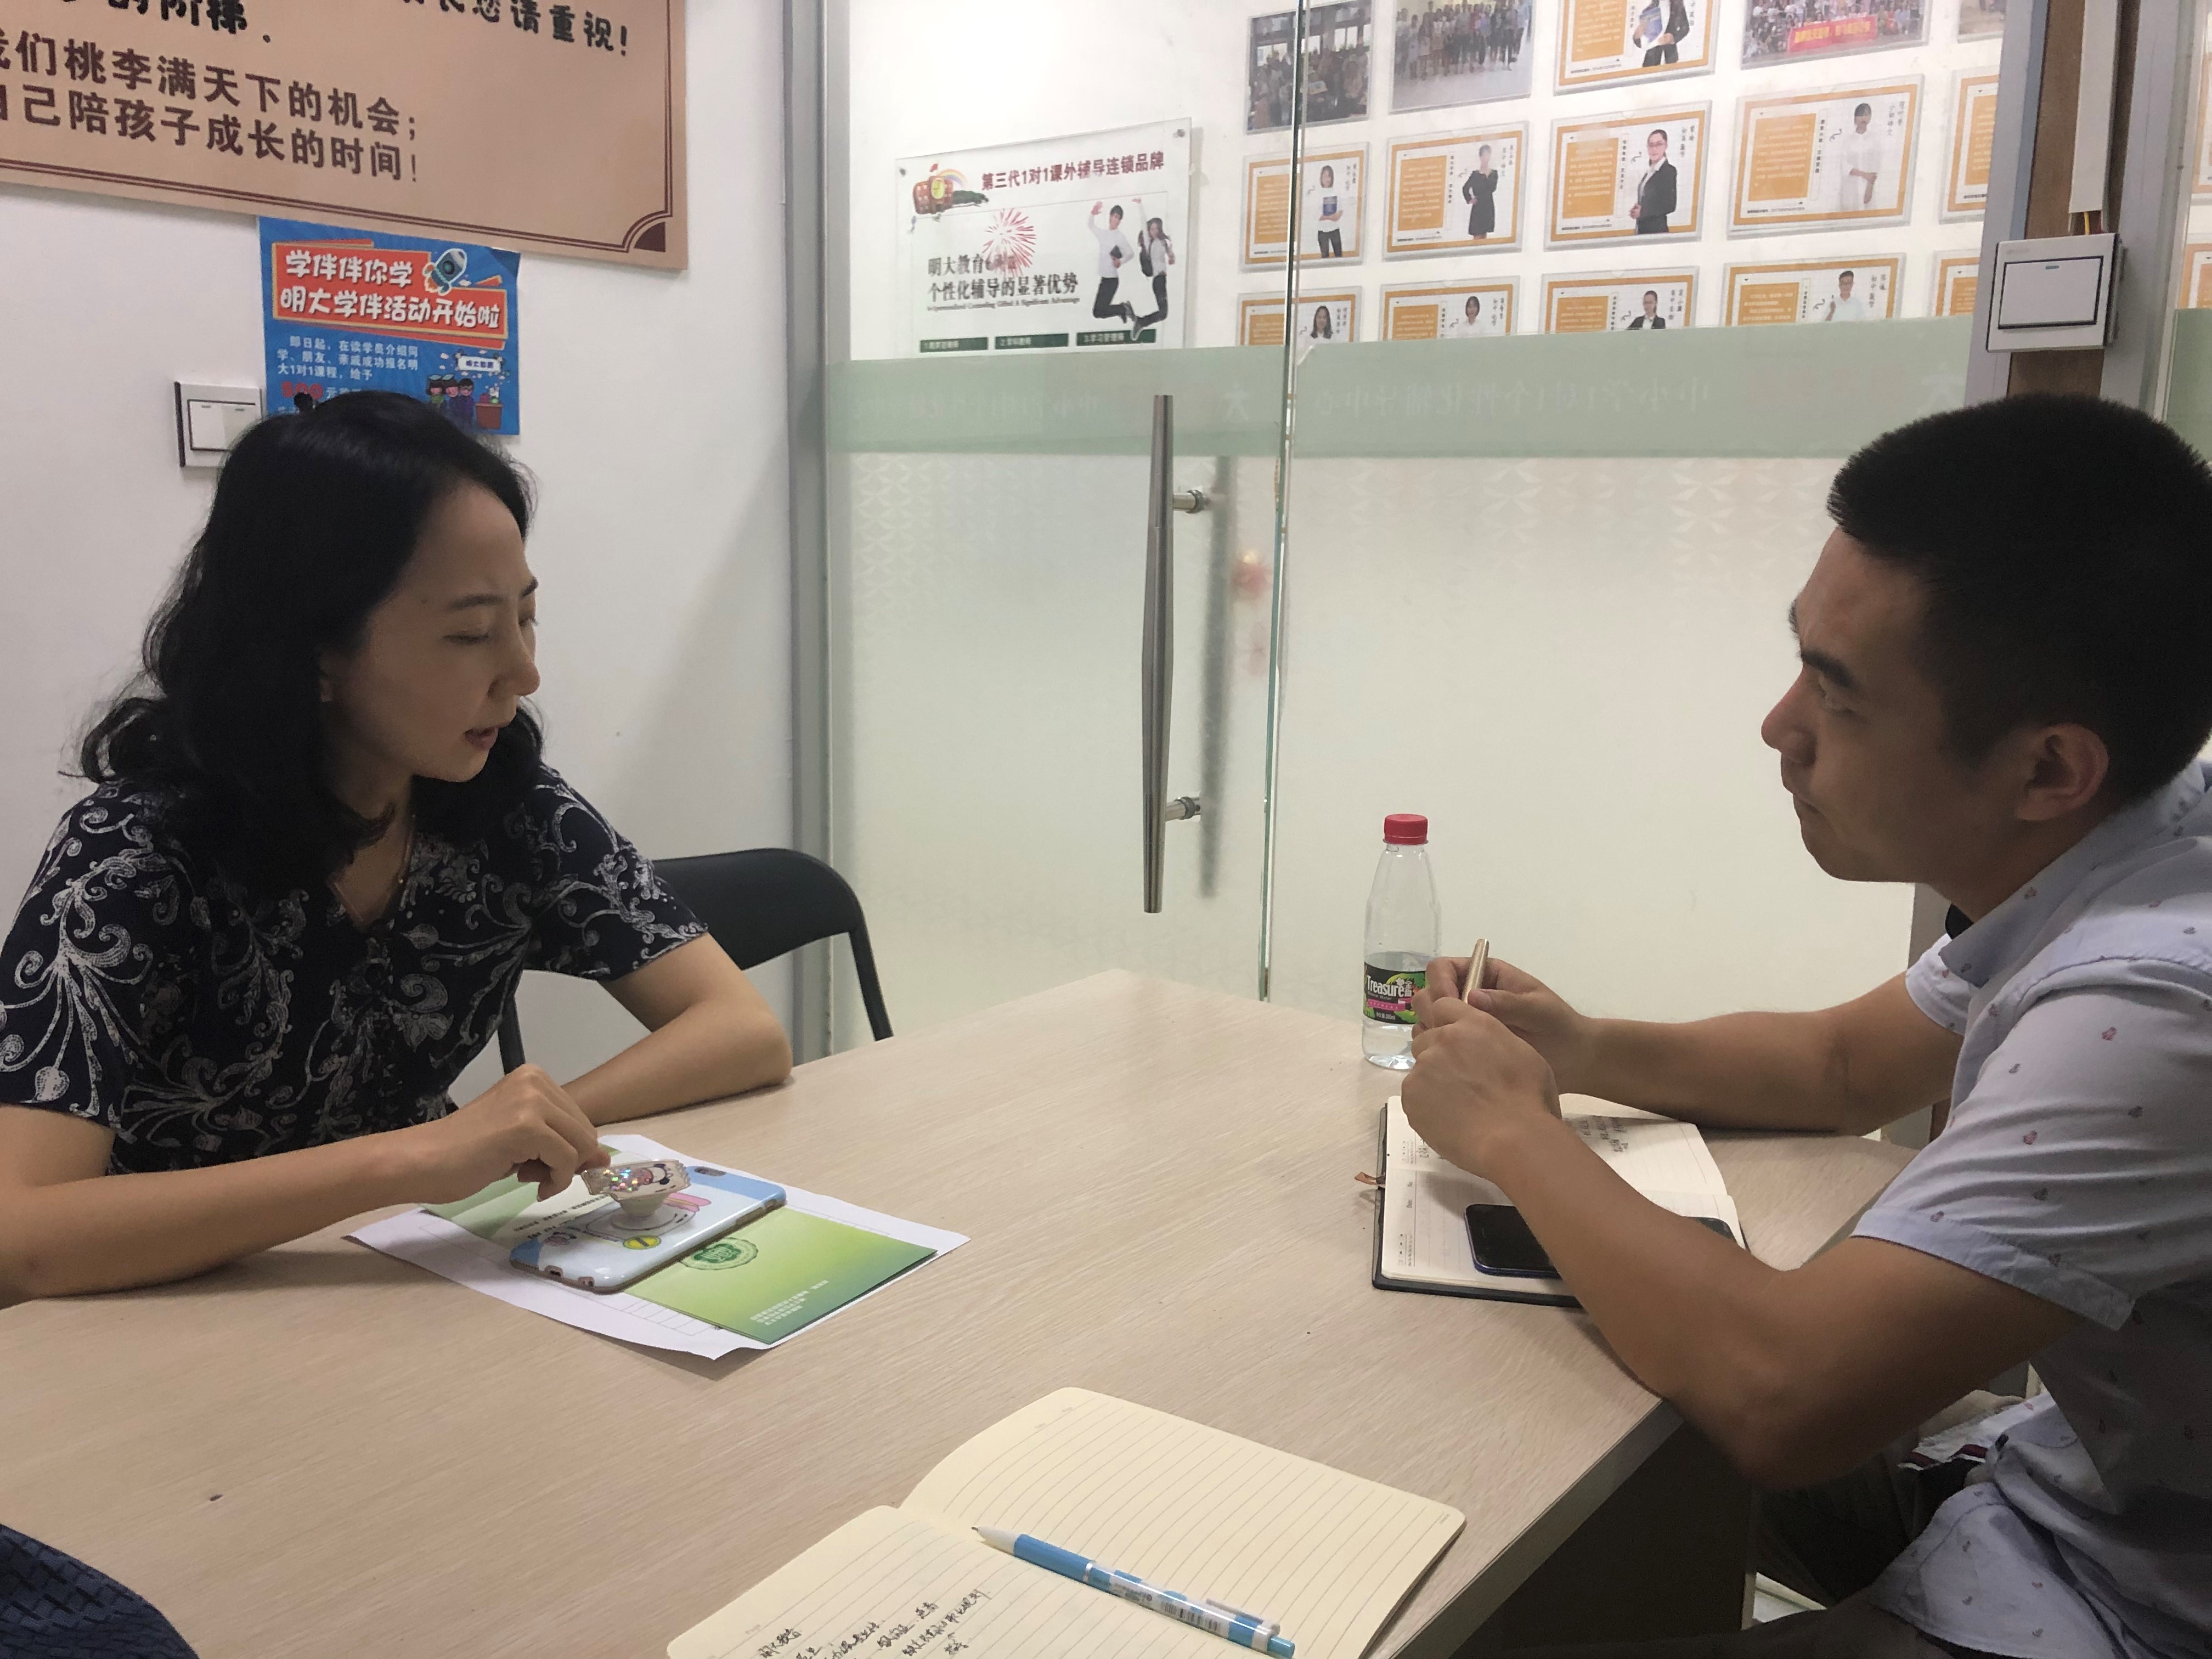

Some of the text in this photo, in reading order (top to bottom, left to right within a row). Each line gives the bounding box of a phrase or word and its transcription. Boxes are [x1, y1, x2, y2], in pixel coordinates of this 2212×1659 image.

[403, 0, 627, 55] 您请重视!
[0, 84, 416, 182] 己陪孩子成长的时间!
[981, 151, 1164, 190] 第三代1对1课外辅导连锁品牌
[285, 250, 413, 288] 学伴伴你学
[927, 272, 1079, 302] 个性化辅导的显著优势
[280, 285, 500, 329] 明大学伴活动开始啦
[1367, 975, 1404, 997] Treasure
